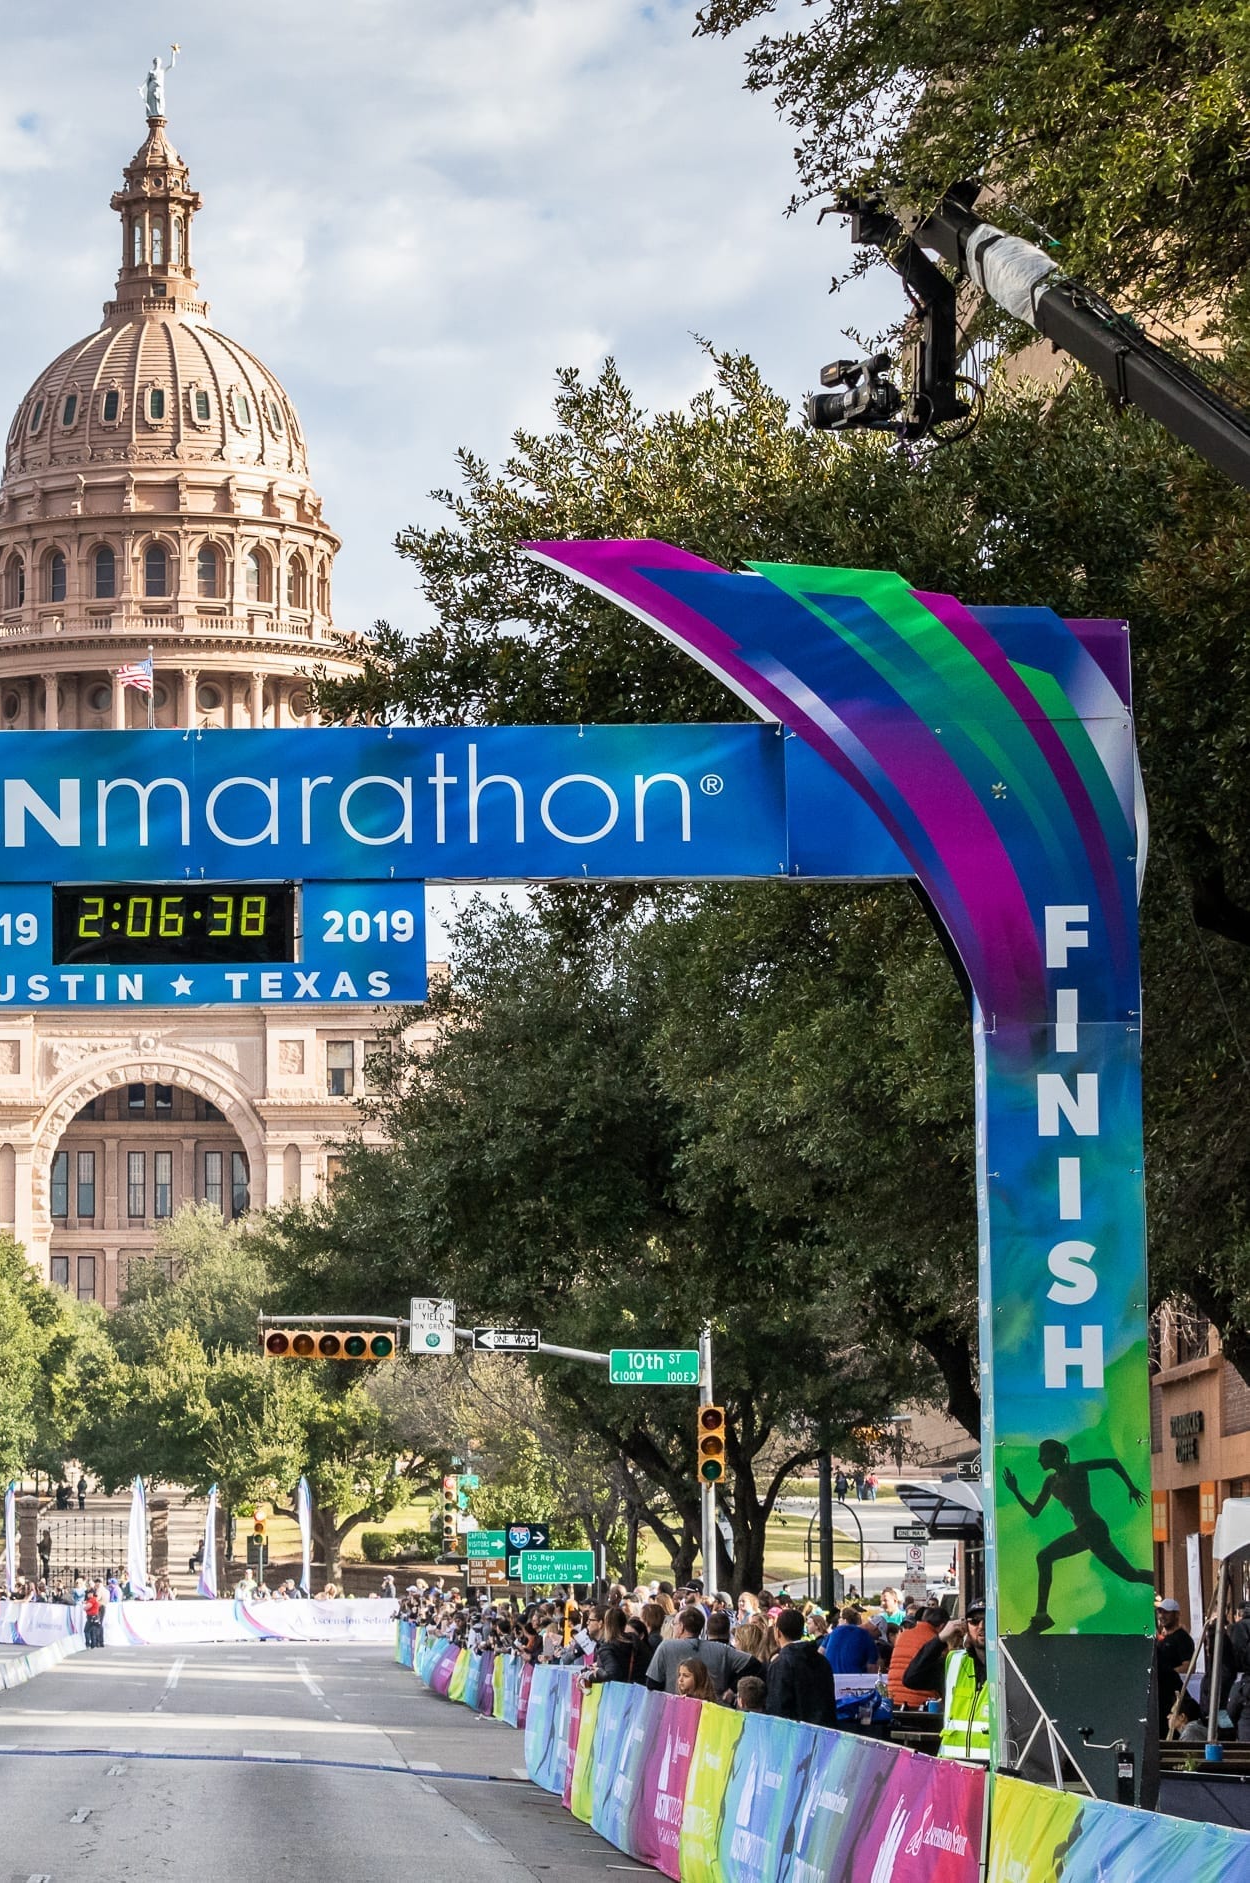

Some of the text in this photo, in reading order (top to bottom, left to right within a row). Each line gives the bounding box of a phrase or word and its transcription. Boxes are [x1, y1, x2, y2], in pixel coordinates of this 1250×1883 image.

[322, 909, 414, 943] 2019
[224, 970, 391, 998] TEXAS
[1036, 905, 1105, 1389] FINISH
[422, 1312, 445, 1321] YIELD
[494, 1335, 534, 1344] ONE WAY
[628, 1352, 682, 1370] 10th ST
[620, 1371, 690, 1382] 100W 100E
[512, 1532, 528, 1544] 35
[540, 1554, 555, 1562] Rep
[527, 1563, 588, 1572] Roger Williams
[310, 1615, 361, 1625] Ascension
